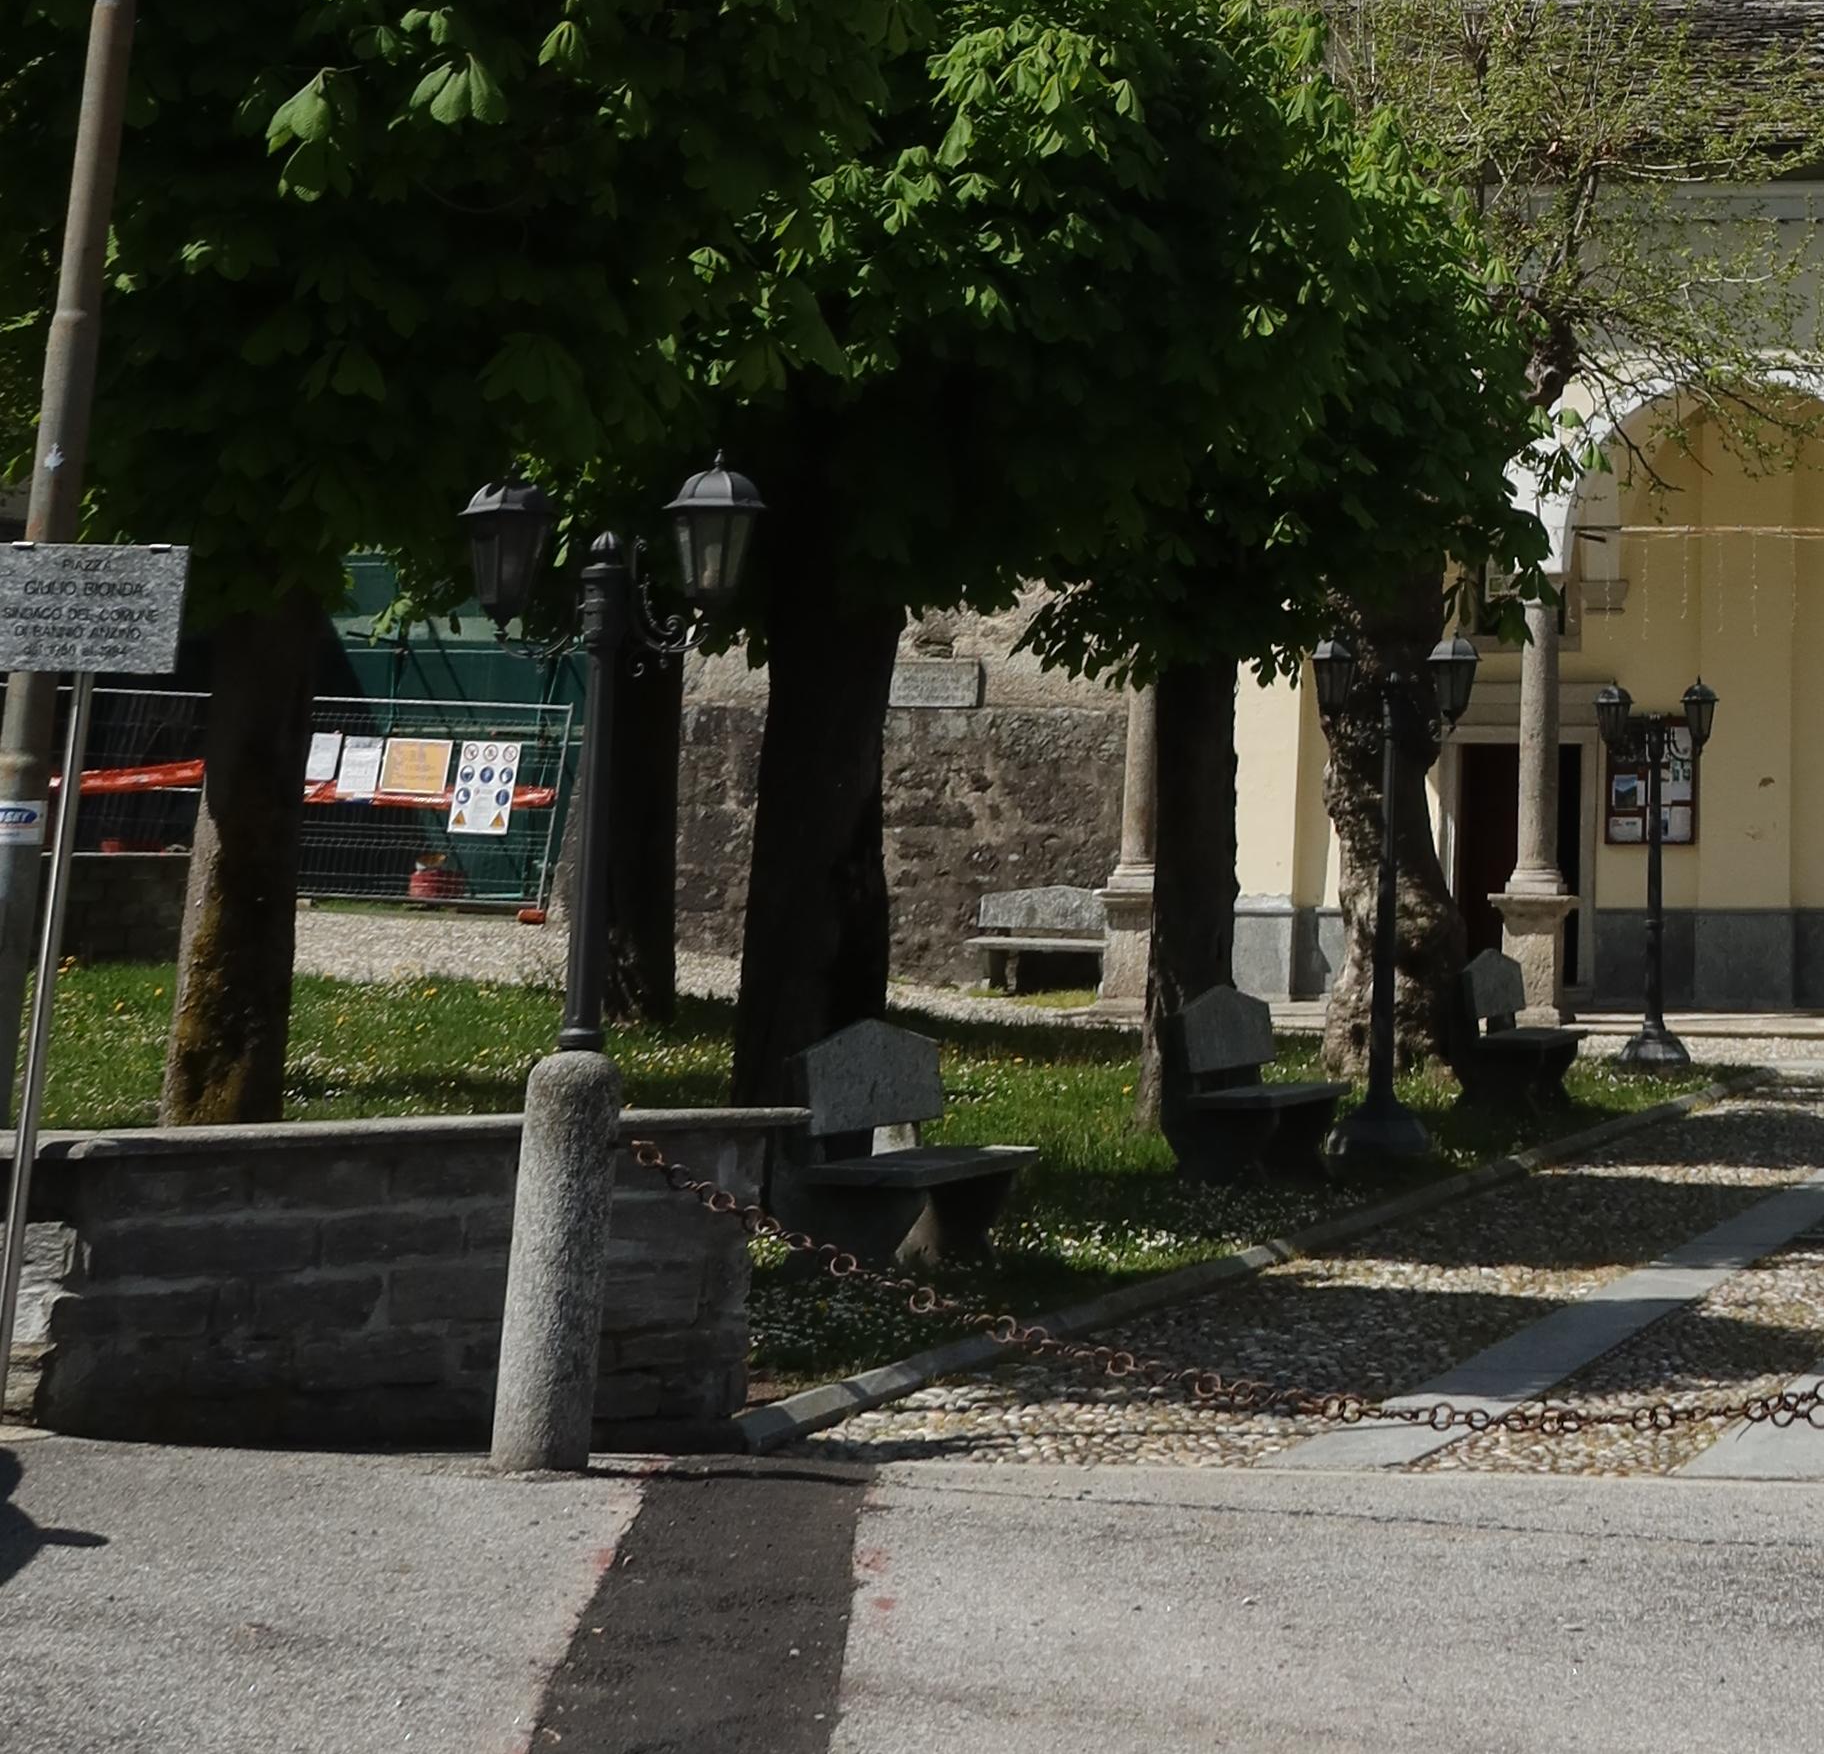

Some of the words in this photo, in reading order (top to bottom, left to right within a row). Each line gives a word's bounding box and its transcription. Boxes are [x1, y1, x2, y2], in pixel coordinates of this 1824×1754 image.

[62, 559, 112, 571] PIAZZA
[24, 580, 77, 596] GIULIO
[83, 582, 146, 597] BIONDA
[3, 607, 63, 620] SINDACO
[68, 608, 91, 620] DEL
[99, 608, 159, 622] COMUNE
[14, 624, 27, 637] DI
